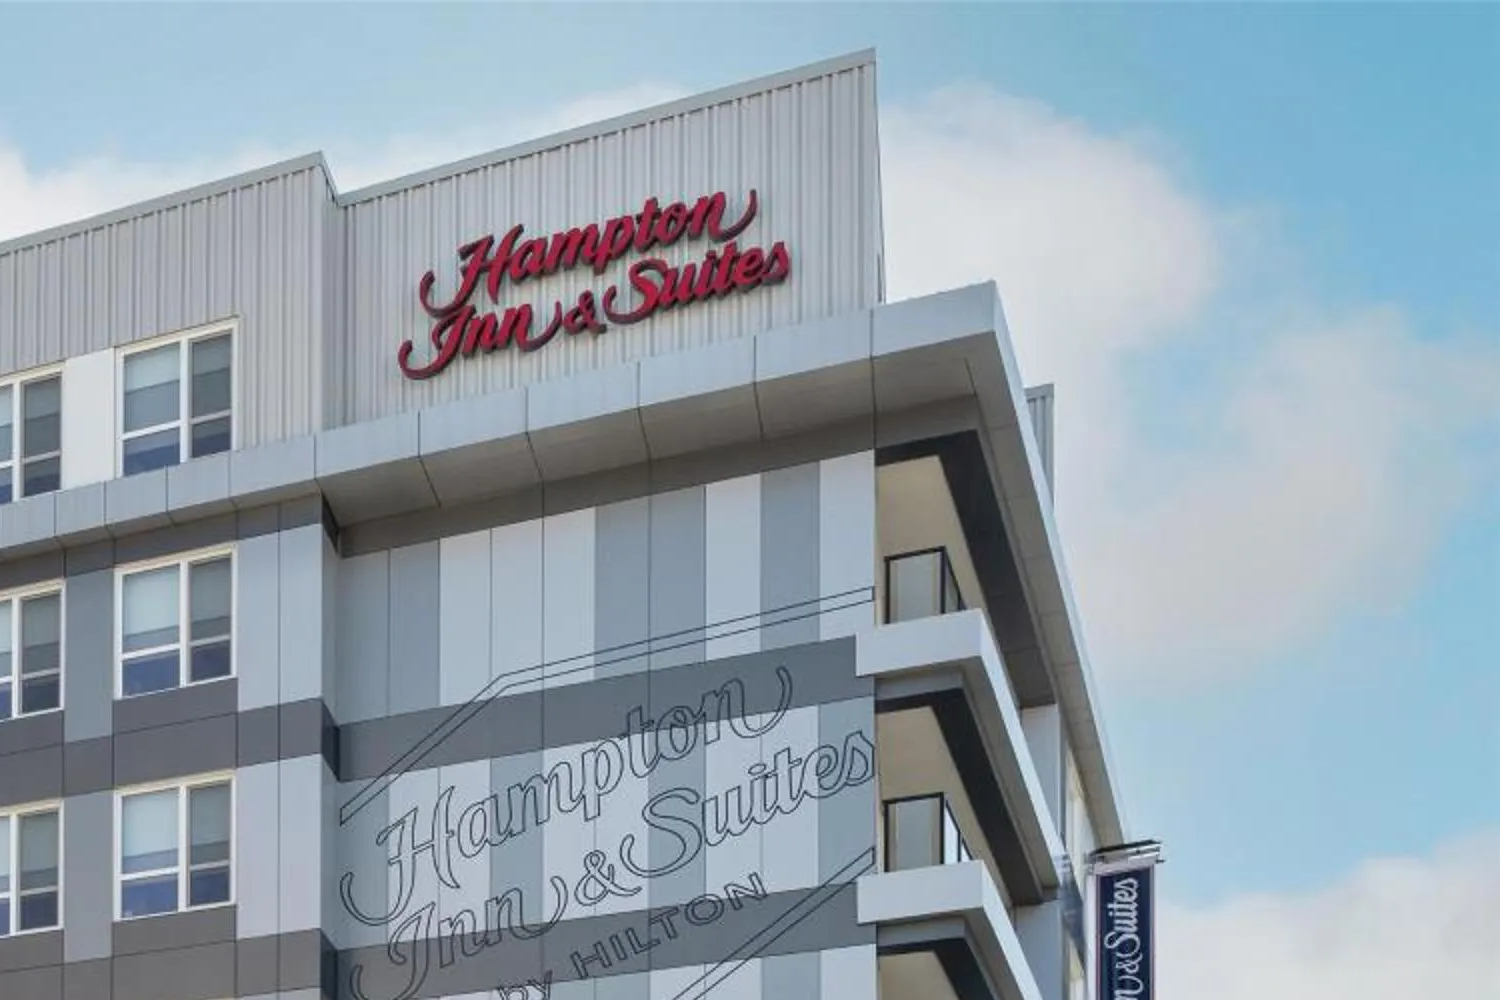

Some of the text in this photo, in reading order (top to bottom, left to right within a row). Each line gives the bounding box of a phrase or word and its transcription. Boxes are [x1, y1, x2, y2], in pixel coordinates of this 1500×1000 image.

[398, 241, 791, 380] Inn & Suites
[419, 189, 757, 318] Hampton
[340, 666, 793, 926] Hampton
[574, 850, 642, 906] &
[621, 730, 876, 877] Suites
[570, 872, 768, 980] HILTON
[1104, 877, 1141, 958] Suites
